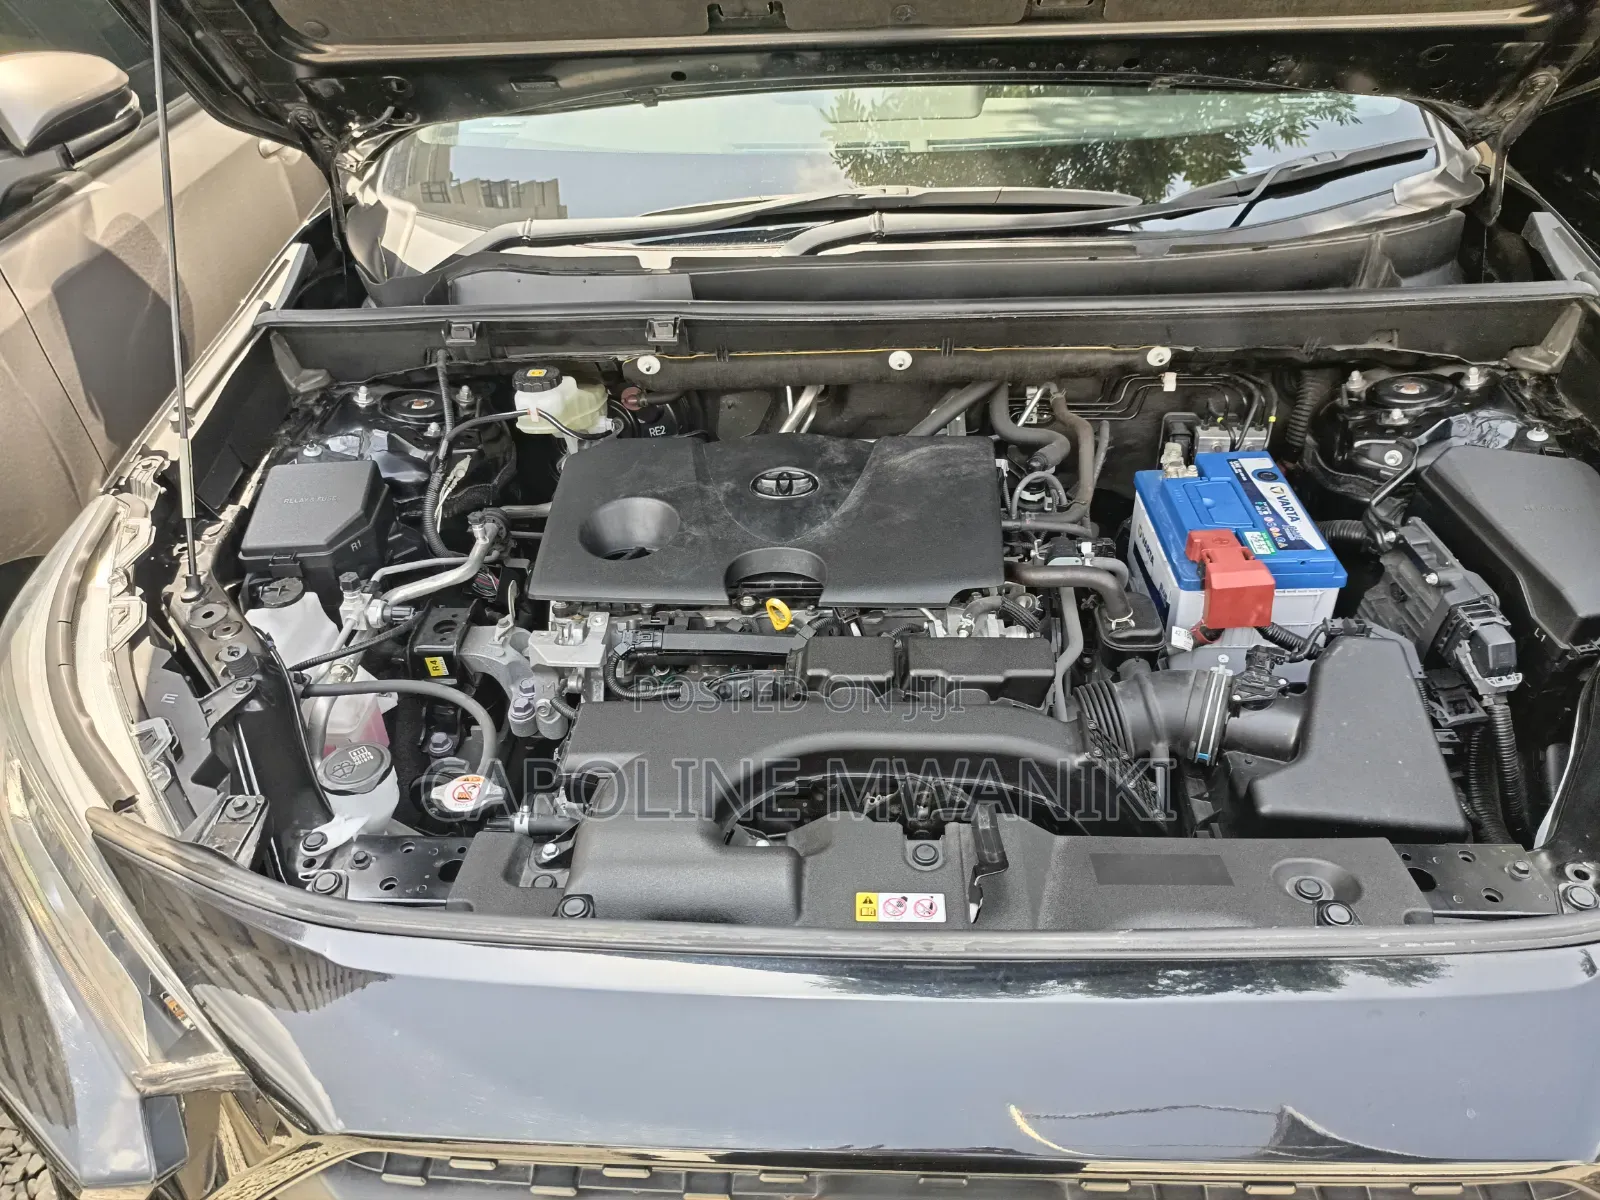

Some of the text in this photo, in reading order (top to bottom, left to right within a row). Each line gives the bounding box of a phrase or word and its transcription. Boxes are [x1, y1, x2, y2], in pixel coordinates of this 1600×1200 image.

[649, 425, 666, 437] RE2
[1277, 494, 1301, 522] VARTA
[350, 540, 362, 552] R1
[430, 660, 440, 671] R4
